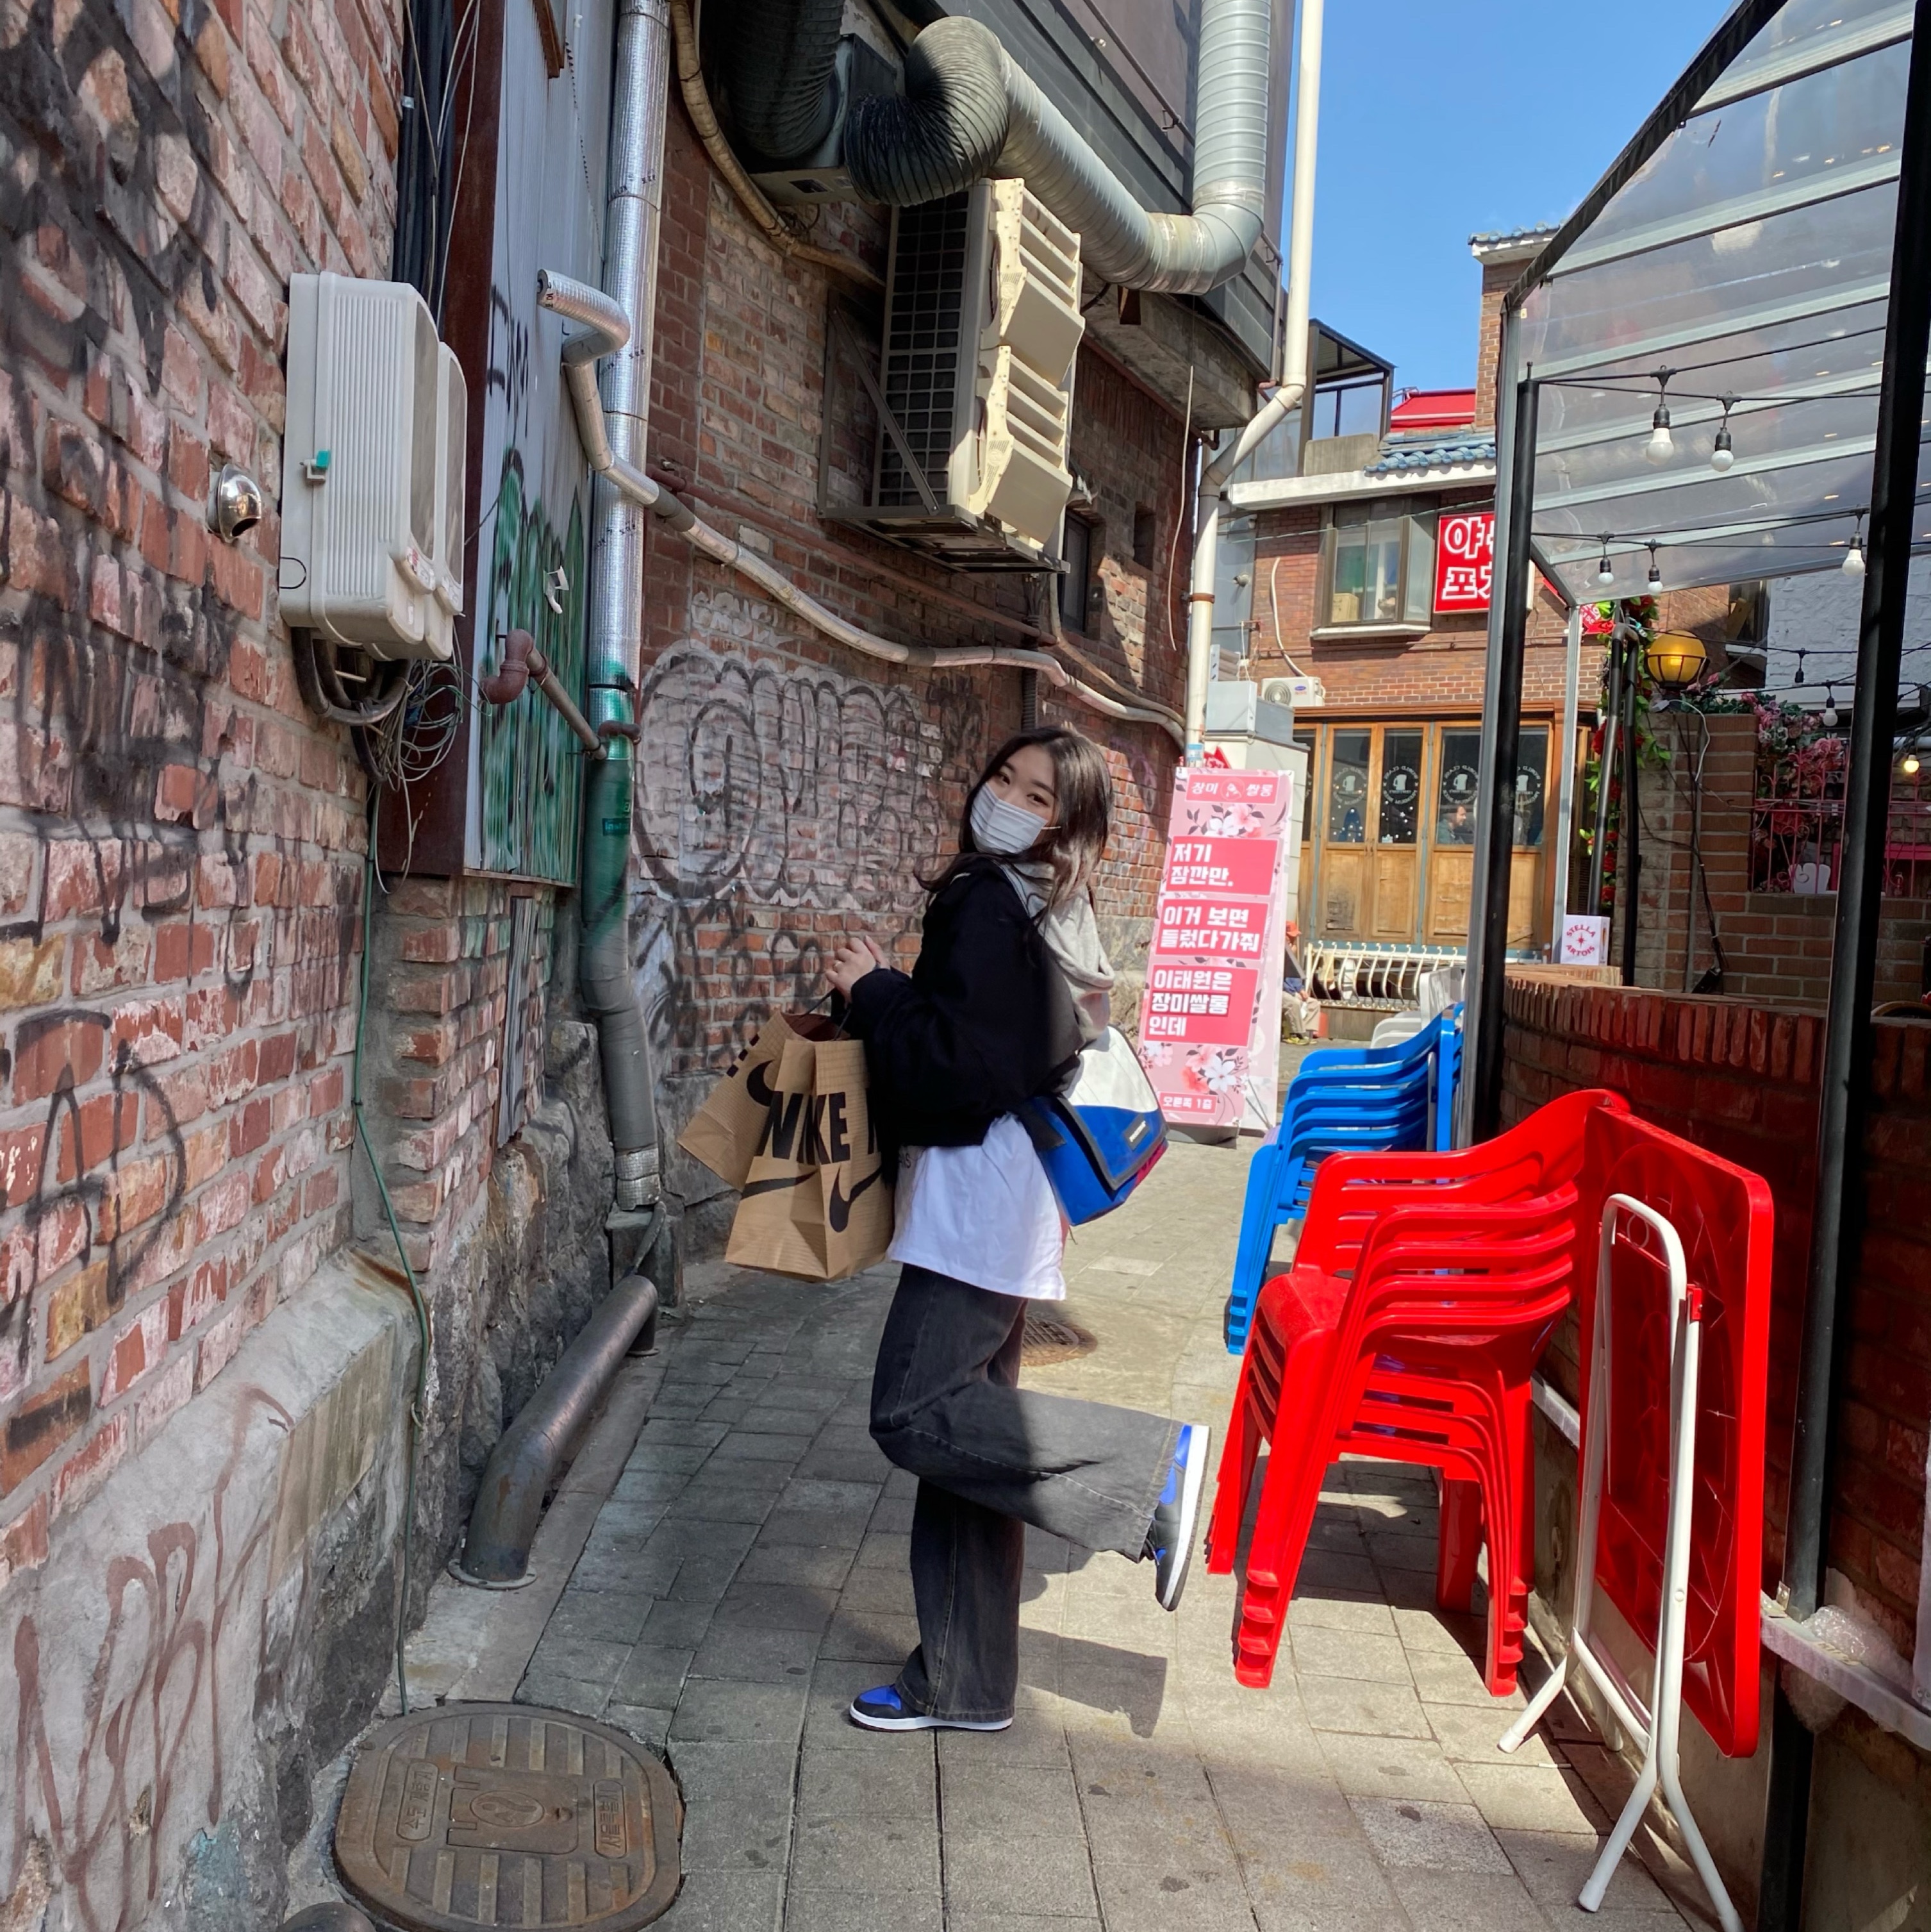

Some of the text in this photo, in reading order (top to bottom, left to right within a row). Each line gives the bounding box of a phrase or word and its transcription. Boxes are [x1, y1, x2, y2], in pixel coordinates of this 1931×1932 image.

[1445, 516, 1495, 559] 야
[1191, 781, 1273, 797] 장미 쌀롱
[1173, 844, 1213, 863] 저기
[1170, 865, 1234, 887] 잠깐만.
[1163, 906, 1249, 928] 이거 보면
[1566, 924, 1596, 938] STELLA
[1566, 944, 1595, 956] ARTOIS
[1154, 969, 1233, 992] 이태원은
[1151, 992, 1229, 1015] 장미쌀롱
[1148, 1015, 1187, 1037] 인데
[1163, 1095, 1193, 1108] 오른쪽
[756, 1090, 851, 1165] NIKE
